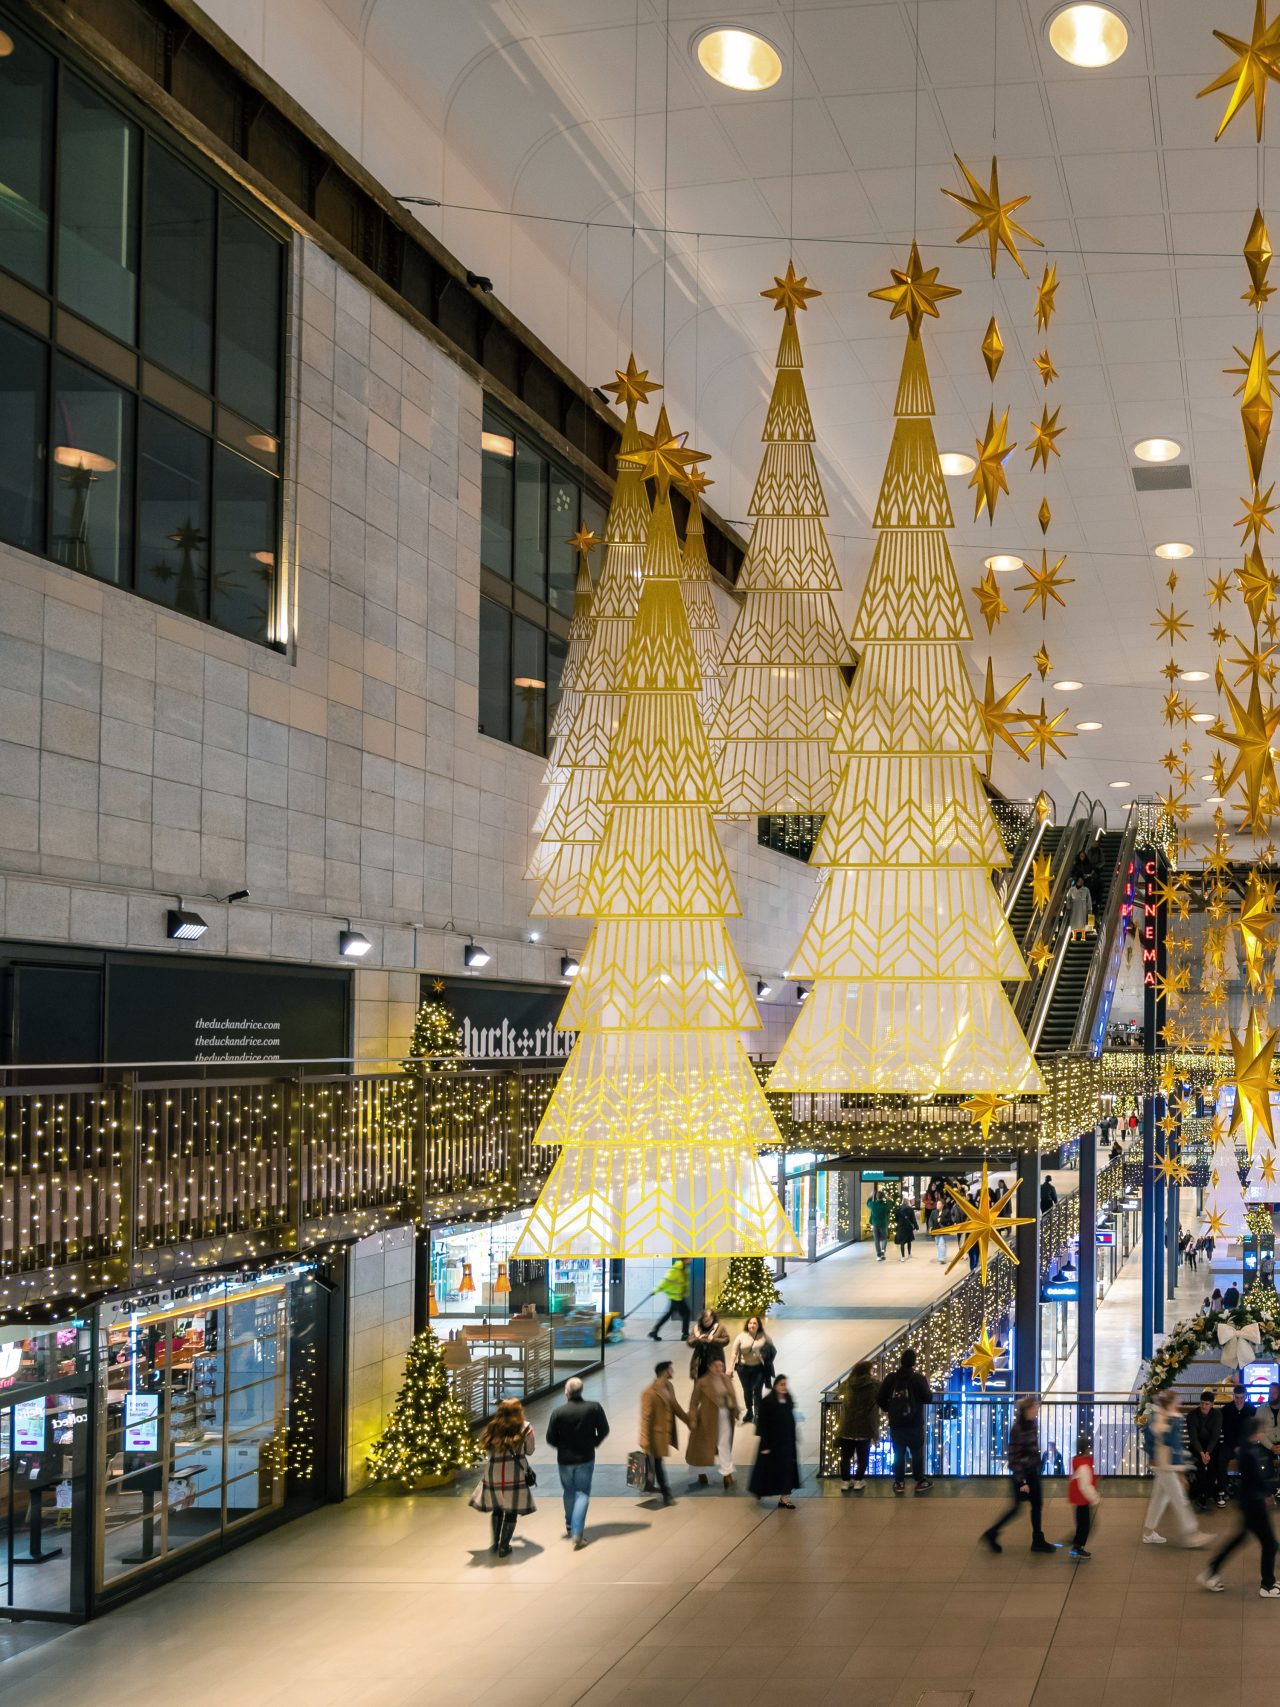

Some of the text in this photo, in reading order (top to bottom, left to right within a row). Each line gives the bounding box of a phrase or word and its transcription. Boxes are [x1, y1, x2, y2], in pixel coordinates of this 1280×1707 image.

[1143, 862, 1156, 984] CINEMA
[195, 1018, 281, 1029] theduckandrice.com
[195, 1035, 281, 1046] theduckandrice.com
